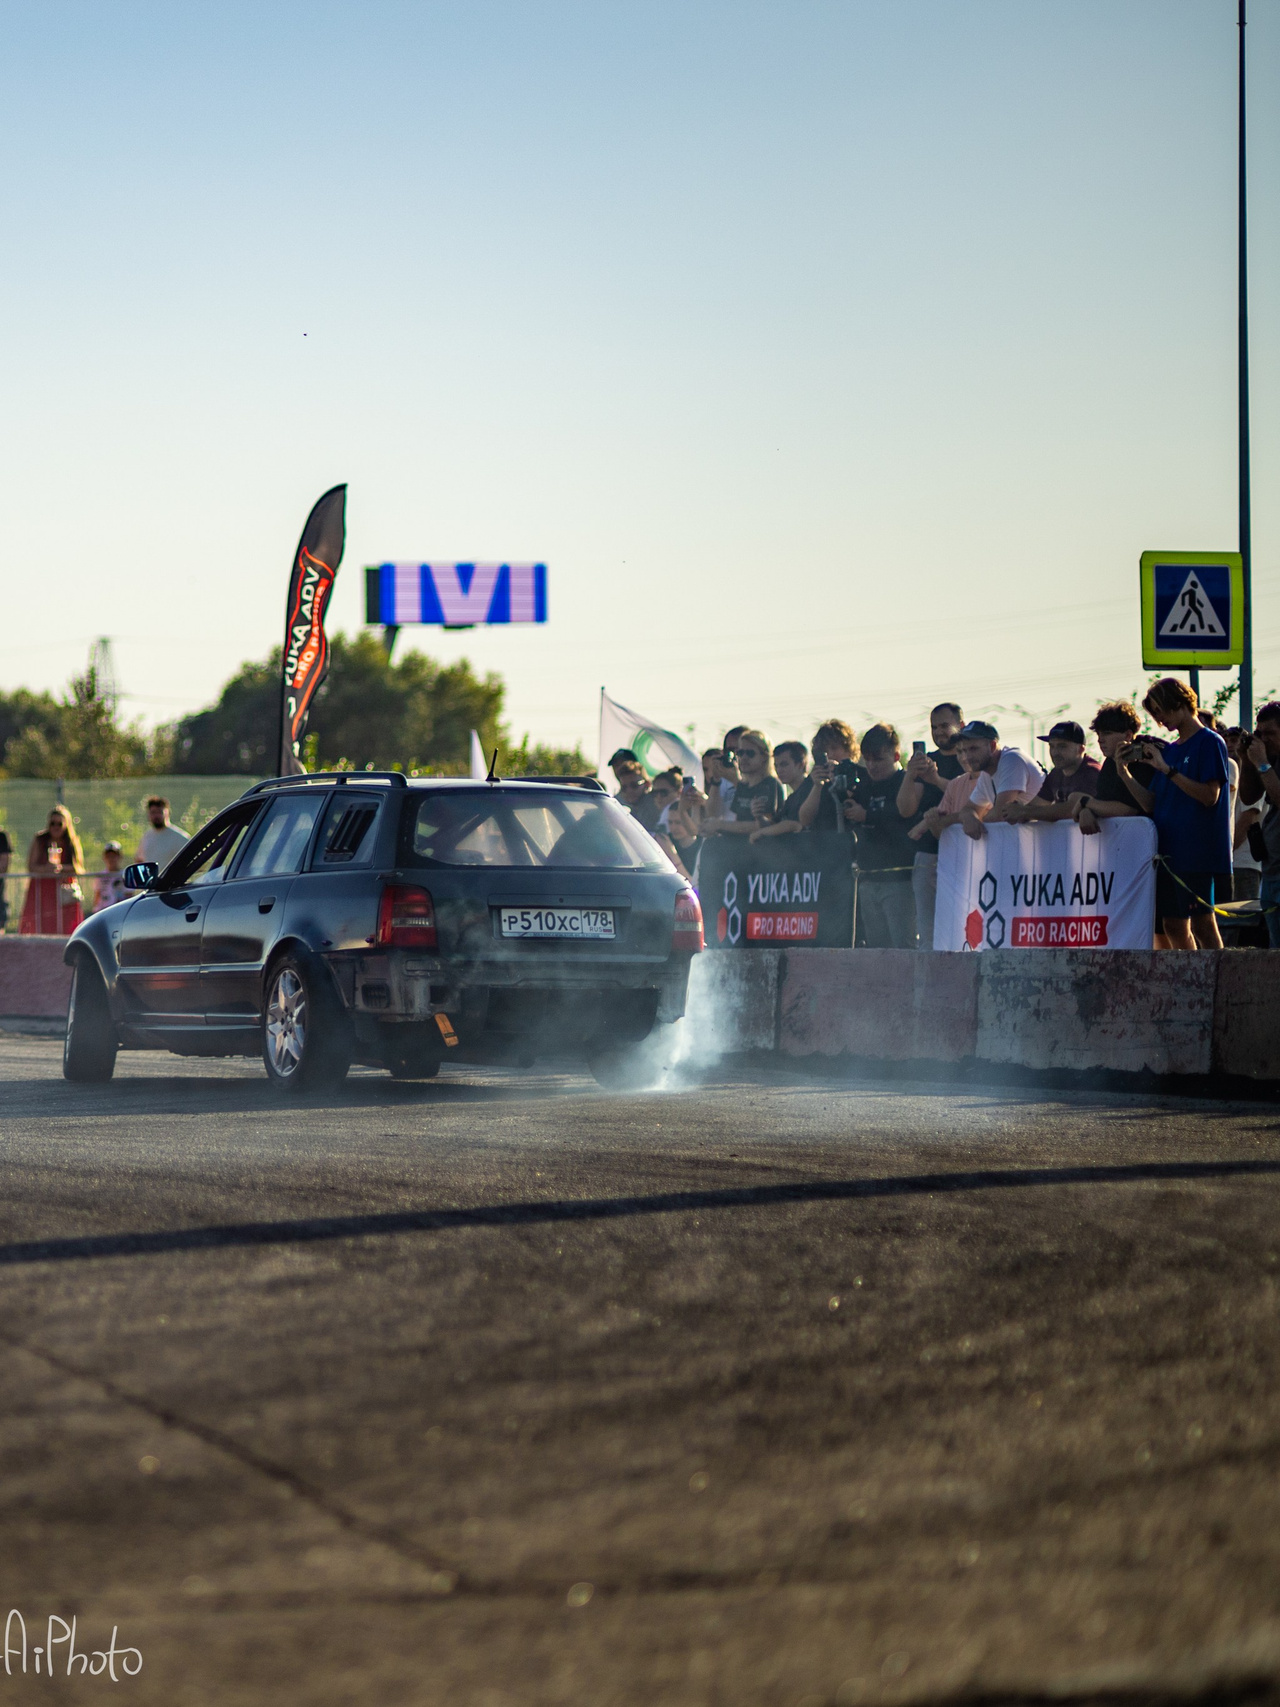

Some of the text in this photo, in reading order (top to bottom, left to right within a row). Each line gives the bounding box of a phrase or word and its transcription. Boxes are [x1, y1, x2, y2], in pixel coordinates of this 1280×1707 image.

[300, 566, 320, 620] ADV
[295, 650, 315, 681] PRO
[748, 871, 821, 904] YUKA ADV
[1010, 871, 1115, 907] YUKA ADV
[583, 911, 609, 927] 178
[753, 916, 814, 935] PRO RACING
[1018, 921, 1101, 943] PRO RACING
